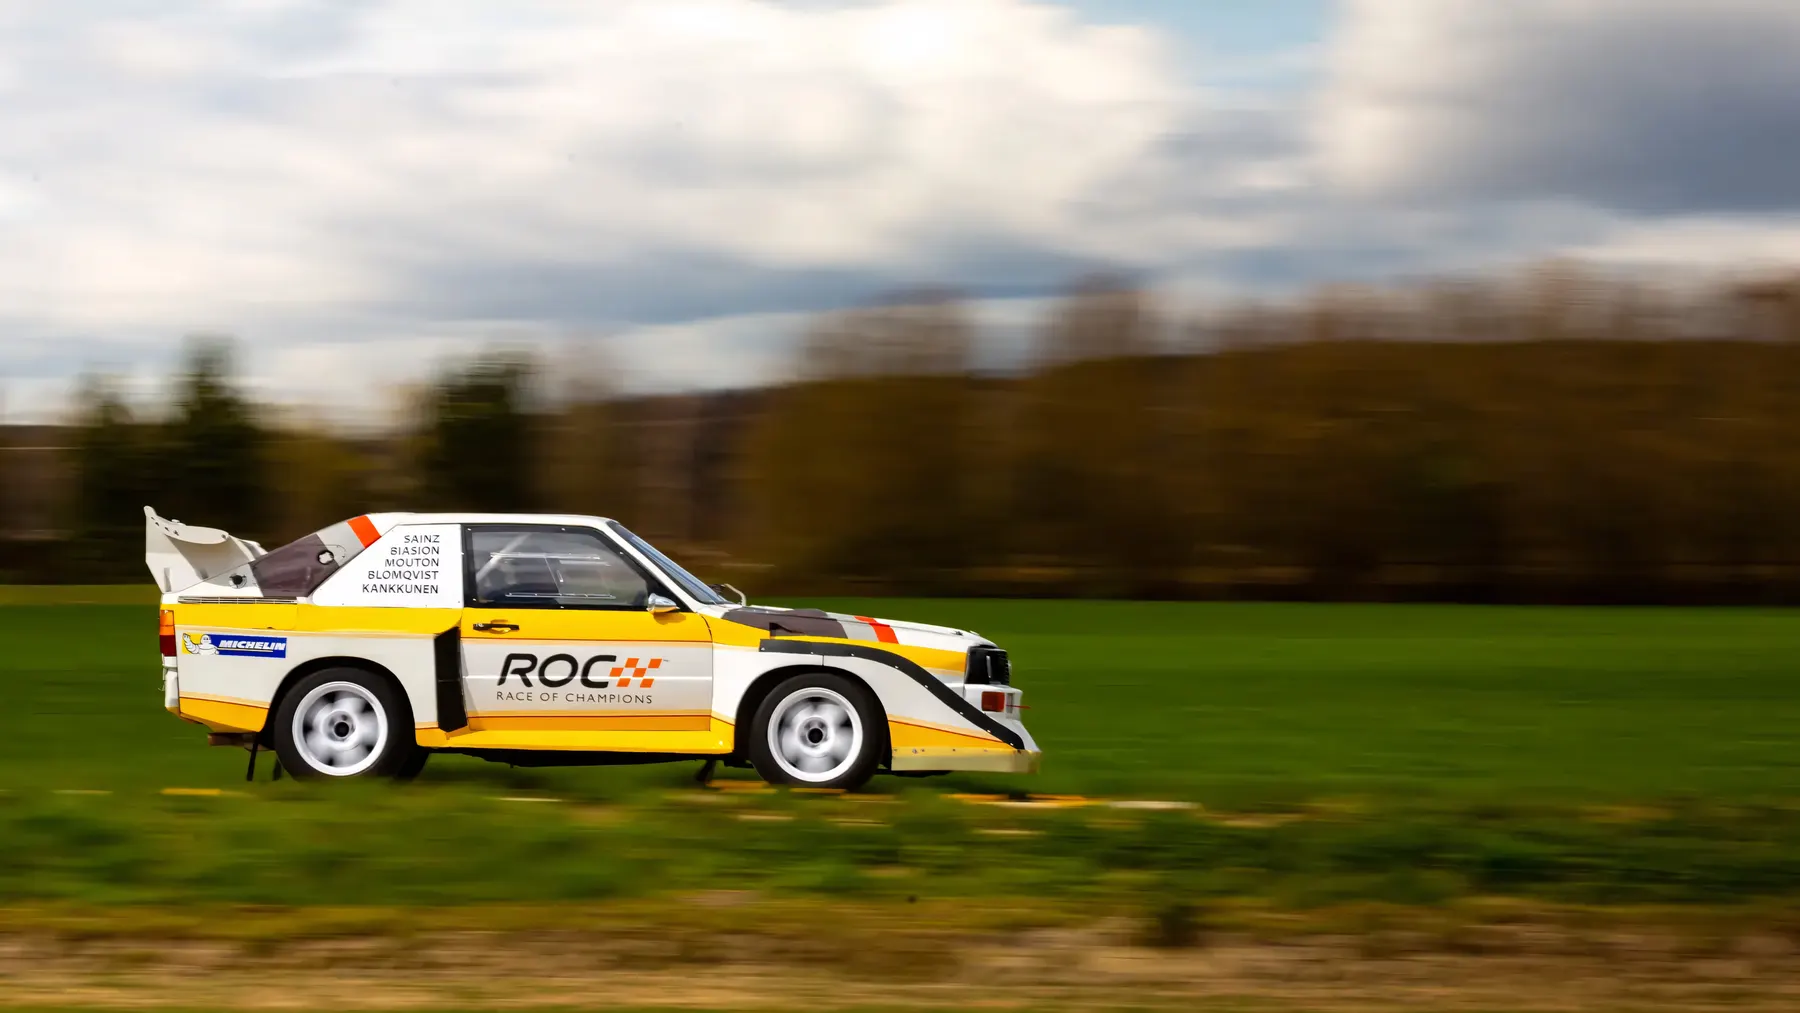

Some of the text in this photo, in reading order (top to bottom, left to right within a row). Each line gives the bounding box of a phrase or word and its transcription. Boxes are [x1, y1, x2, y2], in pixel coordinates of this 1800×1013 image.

[403, 534, 440, 544] SAINZ
[390, 546, 440, 556] BIASION
[384, 558, 440, 567] MOUTON
[367, 570, 439, 581] BLOMQVIST
[362, 583, 439, 594] KANKKUNEN
[218, 639, 287, 651] MICHELIN
[497, 653, 617, 689] ROC
[496, 691, 653, 704] RACE OF CHAMPIONS
